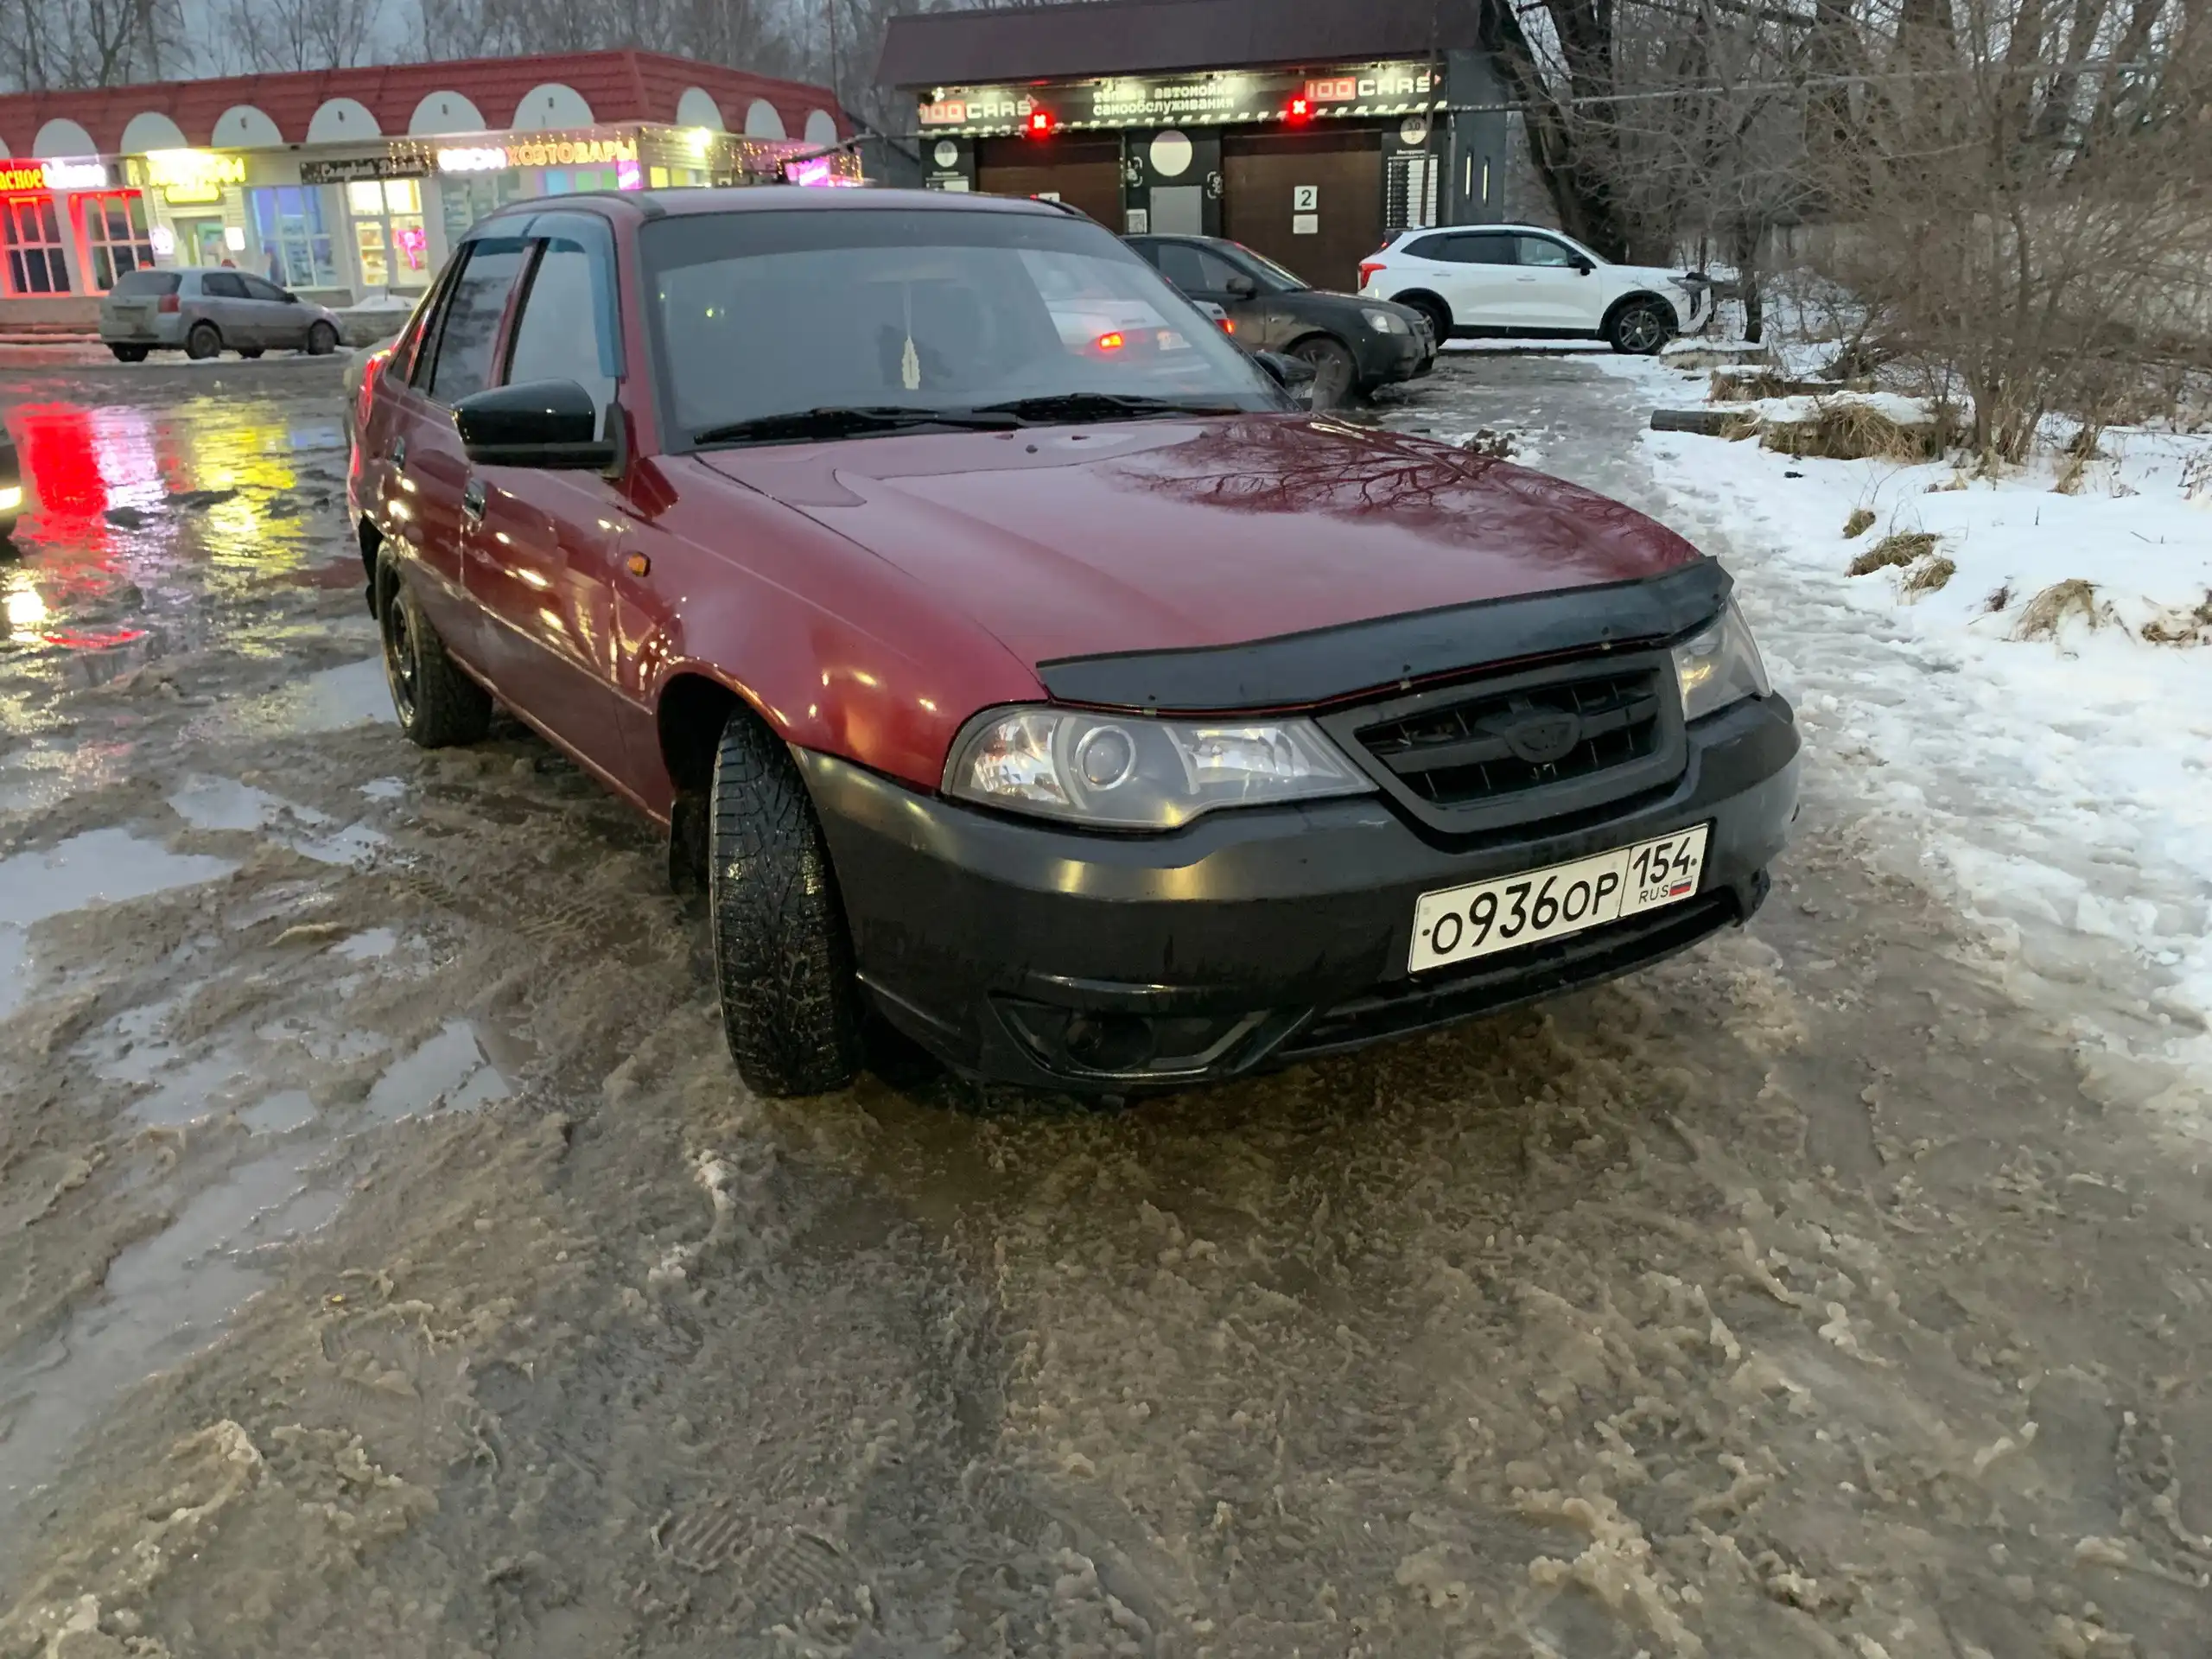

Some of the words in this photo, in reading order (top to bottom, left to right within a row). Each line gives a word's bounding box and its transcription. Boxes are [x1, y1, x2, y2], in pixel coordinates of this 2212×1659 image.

[1093, 98, 1234, 115] самообслуживания
[505, 137, 639, 167] ХОЗТОВАРЫ
[1300, 189, 1312, 207] 2
[1632, 836, 1692, 888] 154
[1638, 886, 1669, 905] RUS
